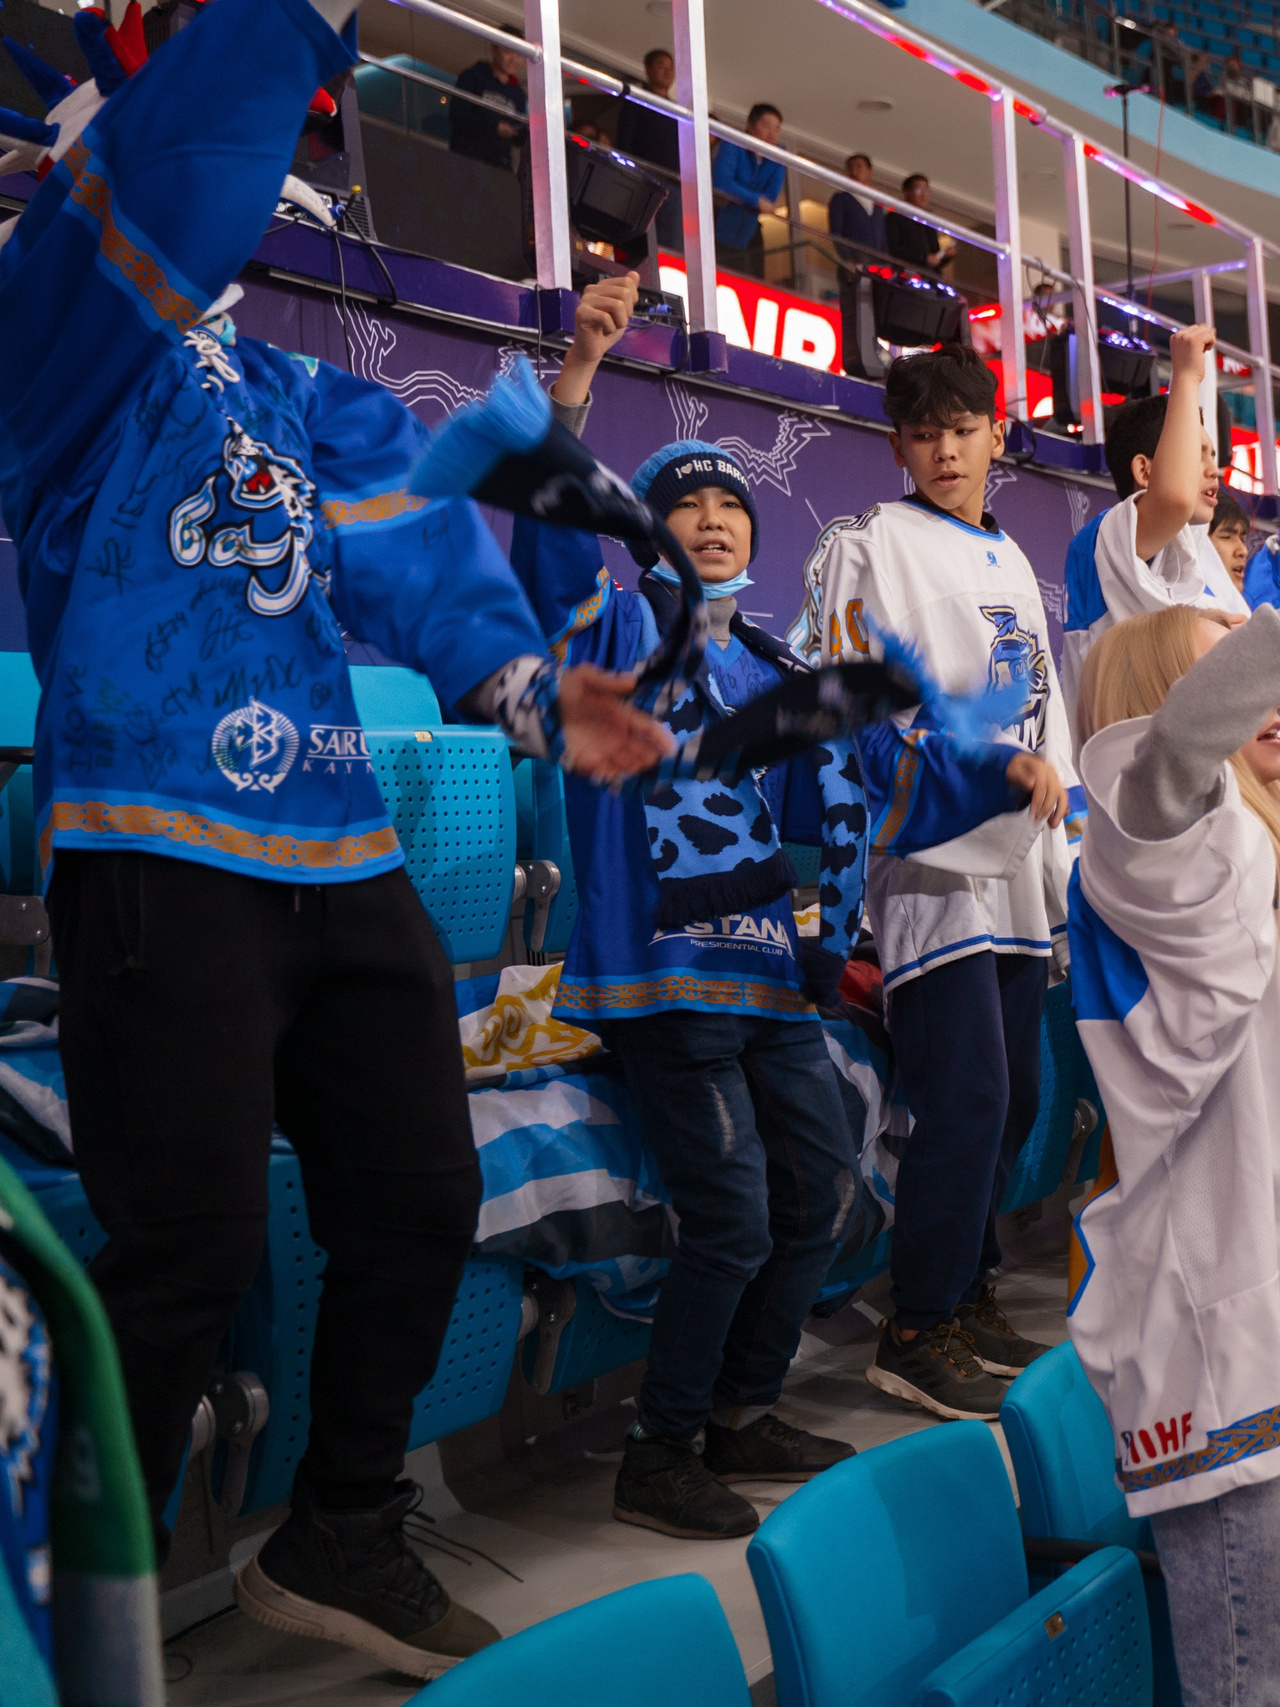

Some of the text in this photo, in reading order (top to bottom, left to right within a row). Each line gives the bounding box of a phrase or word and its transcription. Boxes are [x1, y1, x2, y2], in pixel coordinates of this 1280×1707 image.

[692, 459, 714, 472] HC
[690, 938, 784, 956] PRESIDENTIAL CLUB
